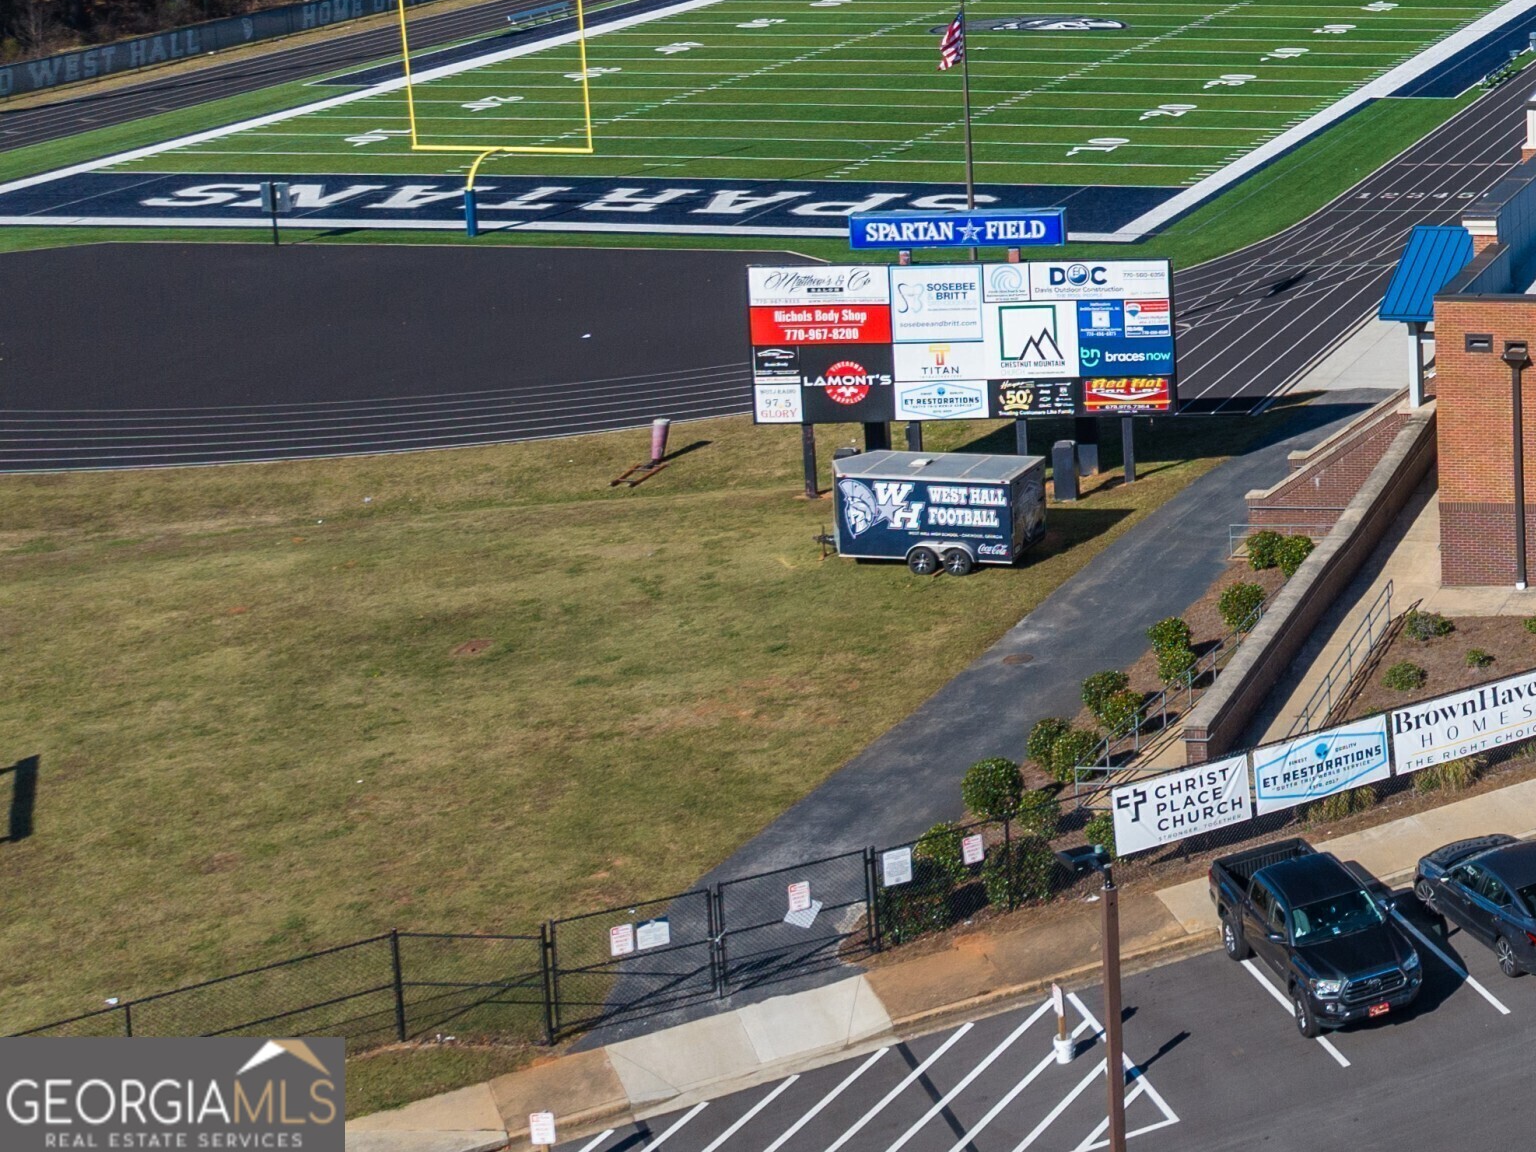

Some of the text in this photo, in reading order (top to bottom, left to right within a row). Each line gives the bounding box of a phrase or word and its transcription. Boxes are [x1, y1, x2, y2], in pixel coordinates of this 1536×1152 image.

[28, 46, 116, 89] WEST
[129, 29, 201, 68] HALL
[865, 220, 1047, 242] SPARTAN FIELD
[926, 282, 976, 291] SOSEBEE
[936, 292, 968, 300] BRITT
[774, 310, 868, 324] Nichols Body Shop
[900, 320, 978, 328] sosebeeandbritt.com
[784, 328, 858, 340] 770-967-8200
[804, 374, 892, 386] LAMONT'S
[922, 366, 960, 374] TITAN
[1092, 378, 1163, 388] Red Hot
[904, 398, 914, 406] ET
[917, 396, 980, 405] RESTORATIONS
[760, 409, 798, 418] GLORY
[927, 486, 1006, 506] WEST HALL
[928, 506, 999, 527] FOOTBALL
[1422, 704, 1532, 748] HOMES
[1288, 742, 1357, 766] FINEST QUALITY
[1406, 755, 1434, 770] THE
[1442, 740, 1488, 760] RIGHT
[1262, 745, 1382, 788] ET RESTORATIONS
[1154, 768, 1230, 800] CHRIST
[1156, 786, 1223, 817] PLACE
[1157, 796, 1243, 832] CHURCH
